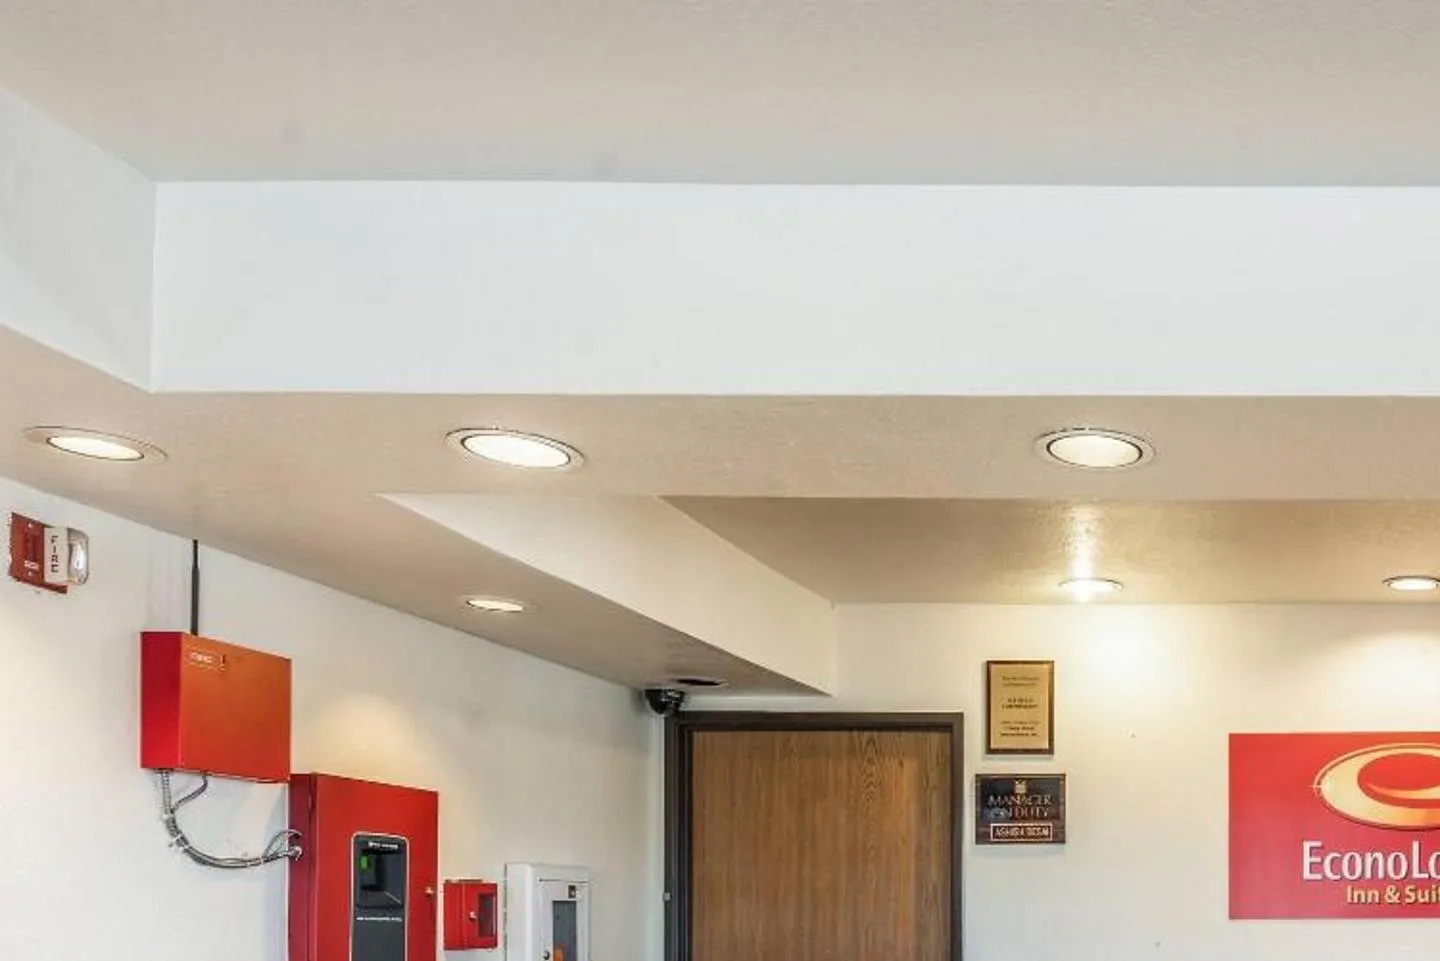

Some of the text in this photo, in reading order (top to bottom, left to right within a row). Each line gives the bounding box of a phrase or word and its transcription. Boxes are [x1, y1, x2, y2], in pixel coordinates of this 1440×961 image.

[51, 534, 59, 573] FIRE
[988, 793, 1052, 806] MANAGER
[1014, 807, 1049, 818] DUTY
[1347, 885, 1380, 904] Inn
[1384, 886, 1401, 904] &
